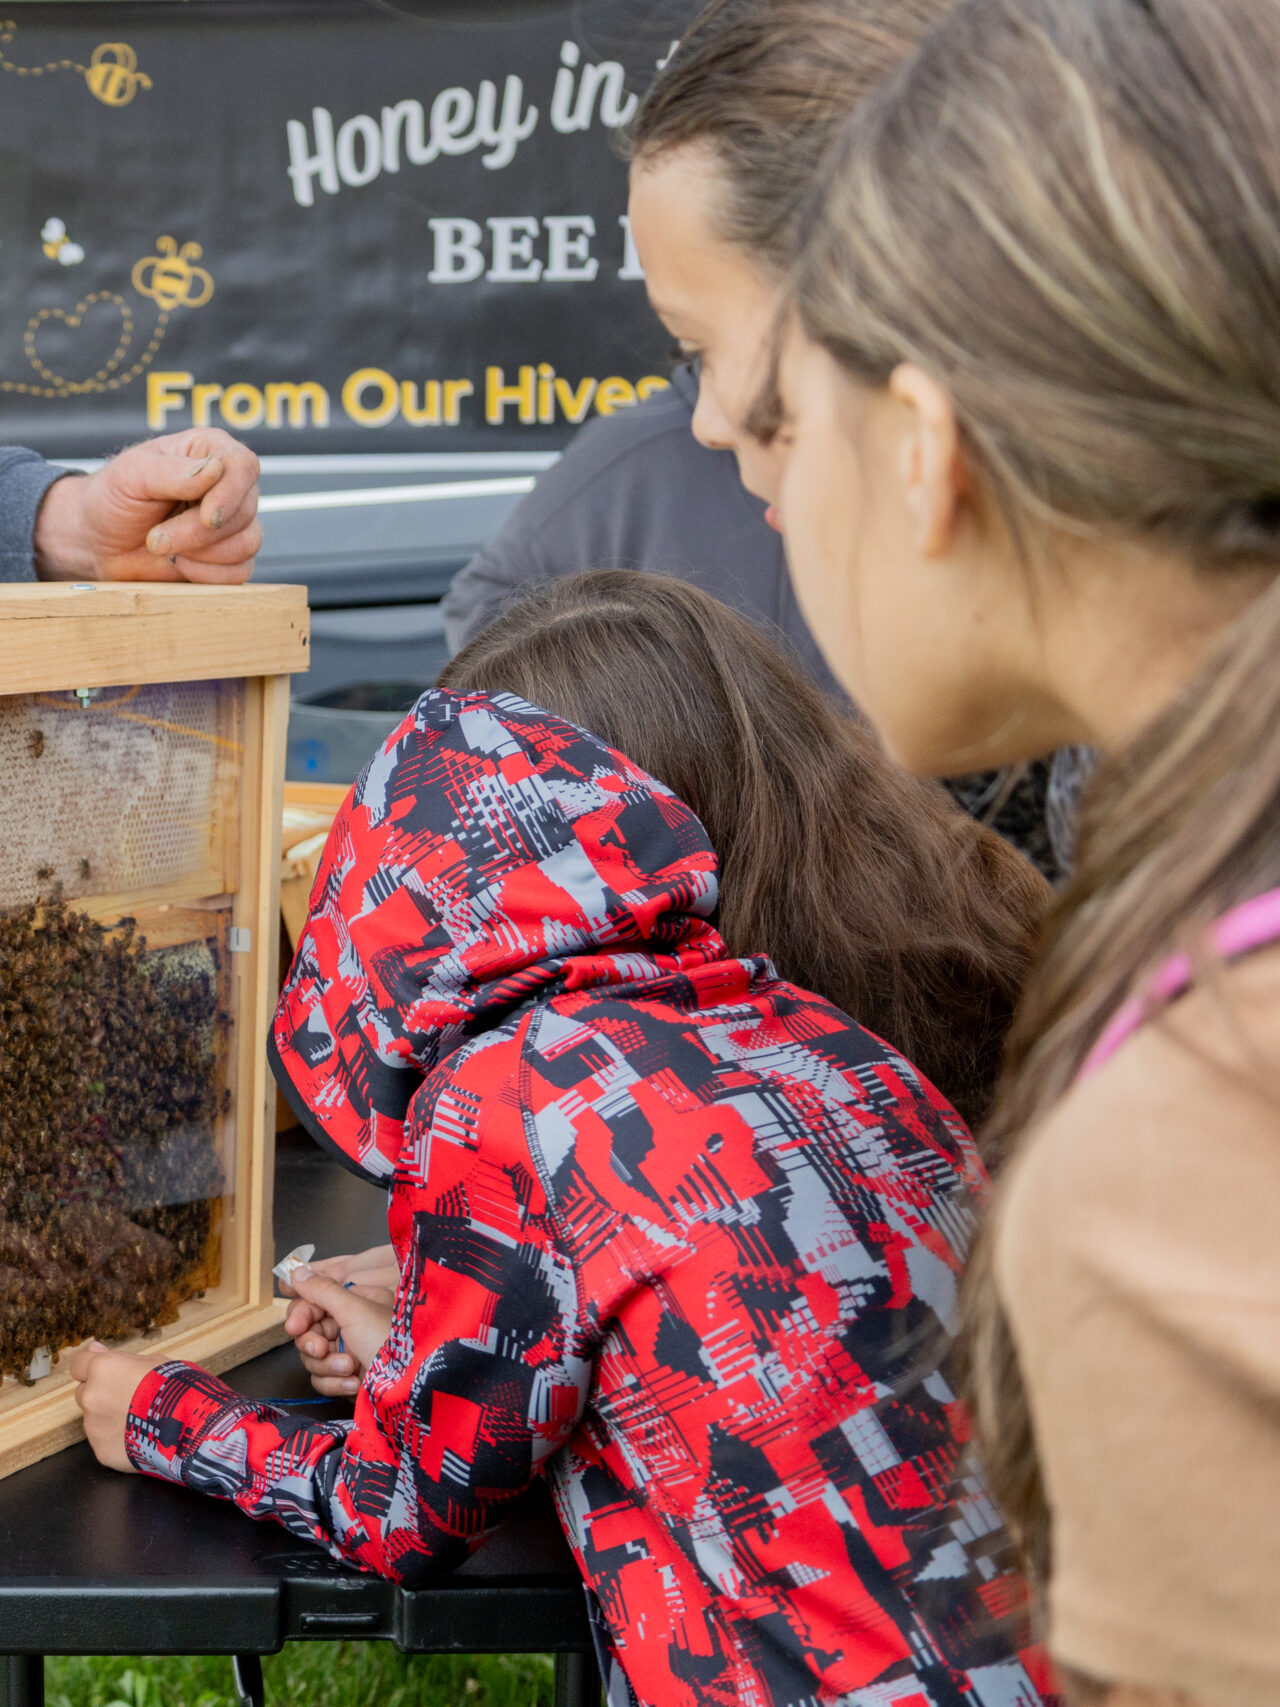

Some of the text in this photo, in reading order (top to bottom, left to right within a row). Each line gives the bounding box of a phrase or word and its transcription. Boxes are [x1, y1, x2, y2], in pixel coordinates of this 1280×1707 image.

[287, 40, 639, 207] Honey in
[428, 215, 599, 284] BEE
[146, 371, 330, 431] From
[341, 367, 473, 429] Our
